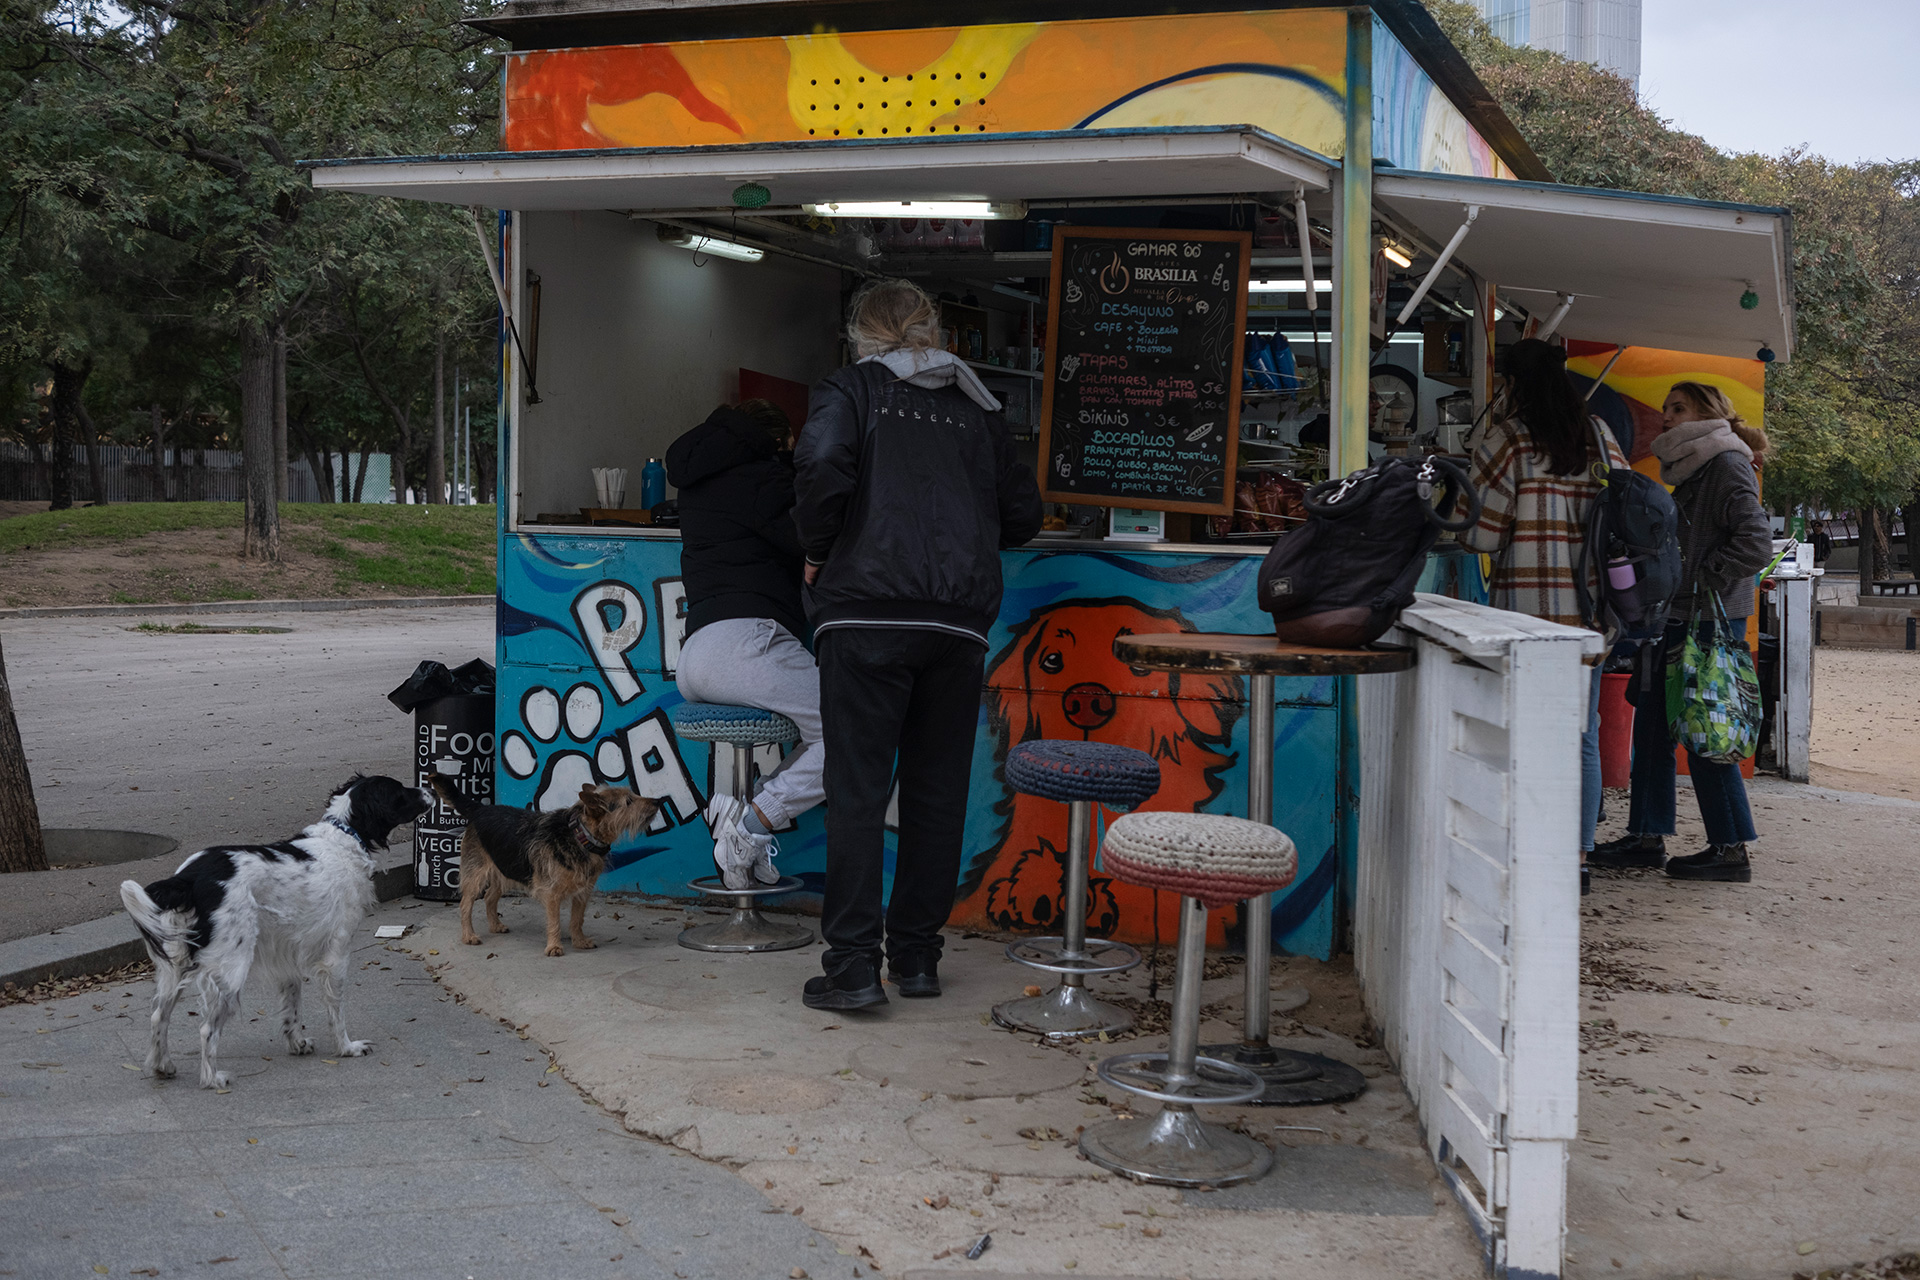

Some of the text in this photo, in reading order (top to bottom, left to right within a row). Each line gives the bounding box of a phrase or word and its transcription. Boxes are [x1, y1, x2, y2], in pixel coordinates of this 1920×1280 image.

[1127, 243, 1178, 257] GAMAR
[1135, 267, 1198, 282] BRASILIA
[1094, 322, 1122, 336] CAFE
[1135, 345, 1172, 354] TOSTADA
[1079, 353, 1128, 373] TAPAS
[1079, 374, 1152, 389] CALAMARES,
[1079, 386, 1119, 399] BRAVAS,
[1124, 388, 1164, 399] PATATAS
[1081, 397, 1100, 406] PAN
[1125, 398, 1163, 407] TOMATE
[1084, 445, 1141, 459] FRANKFURT,
[1143, 450, 1174, 461] ATUN,
[1084, 457, 1186, 475] POLLO, QUESO, BACON,
[1083, 469, 1110, 479] LOMO,
[1112, 482, 1117, 490] A
[1157, 485, 1168, 493] DE
[419, 725, 429, 766] COLD
[431, 855, 440, 887] Lunch
